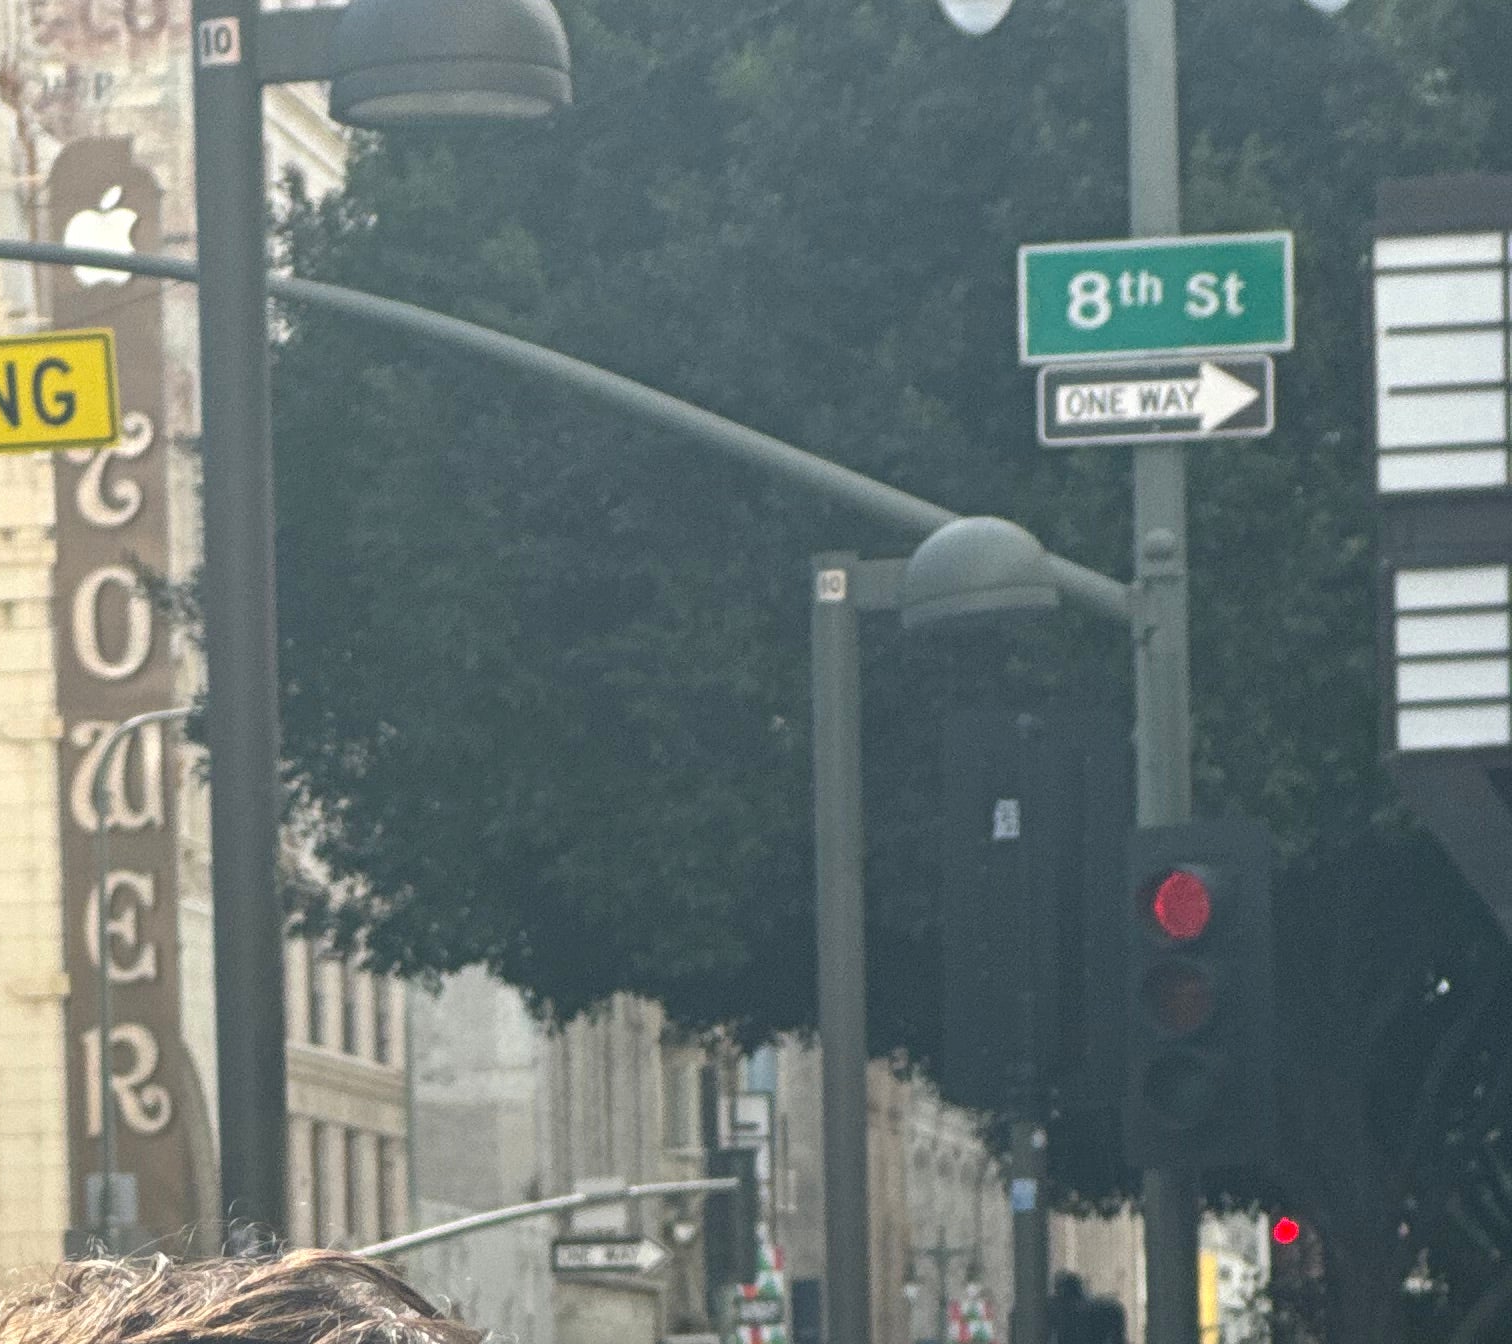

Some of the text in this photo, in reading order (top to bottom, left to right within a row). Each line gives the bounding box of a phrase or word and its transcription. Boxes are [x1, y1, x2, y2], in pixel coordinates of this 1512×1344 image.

[201, 24, 233, 57] 10
[1066, 269, 1247, 331] 8th St
[1064, 382, 1201, 417] ONE WAY
